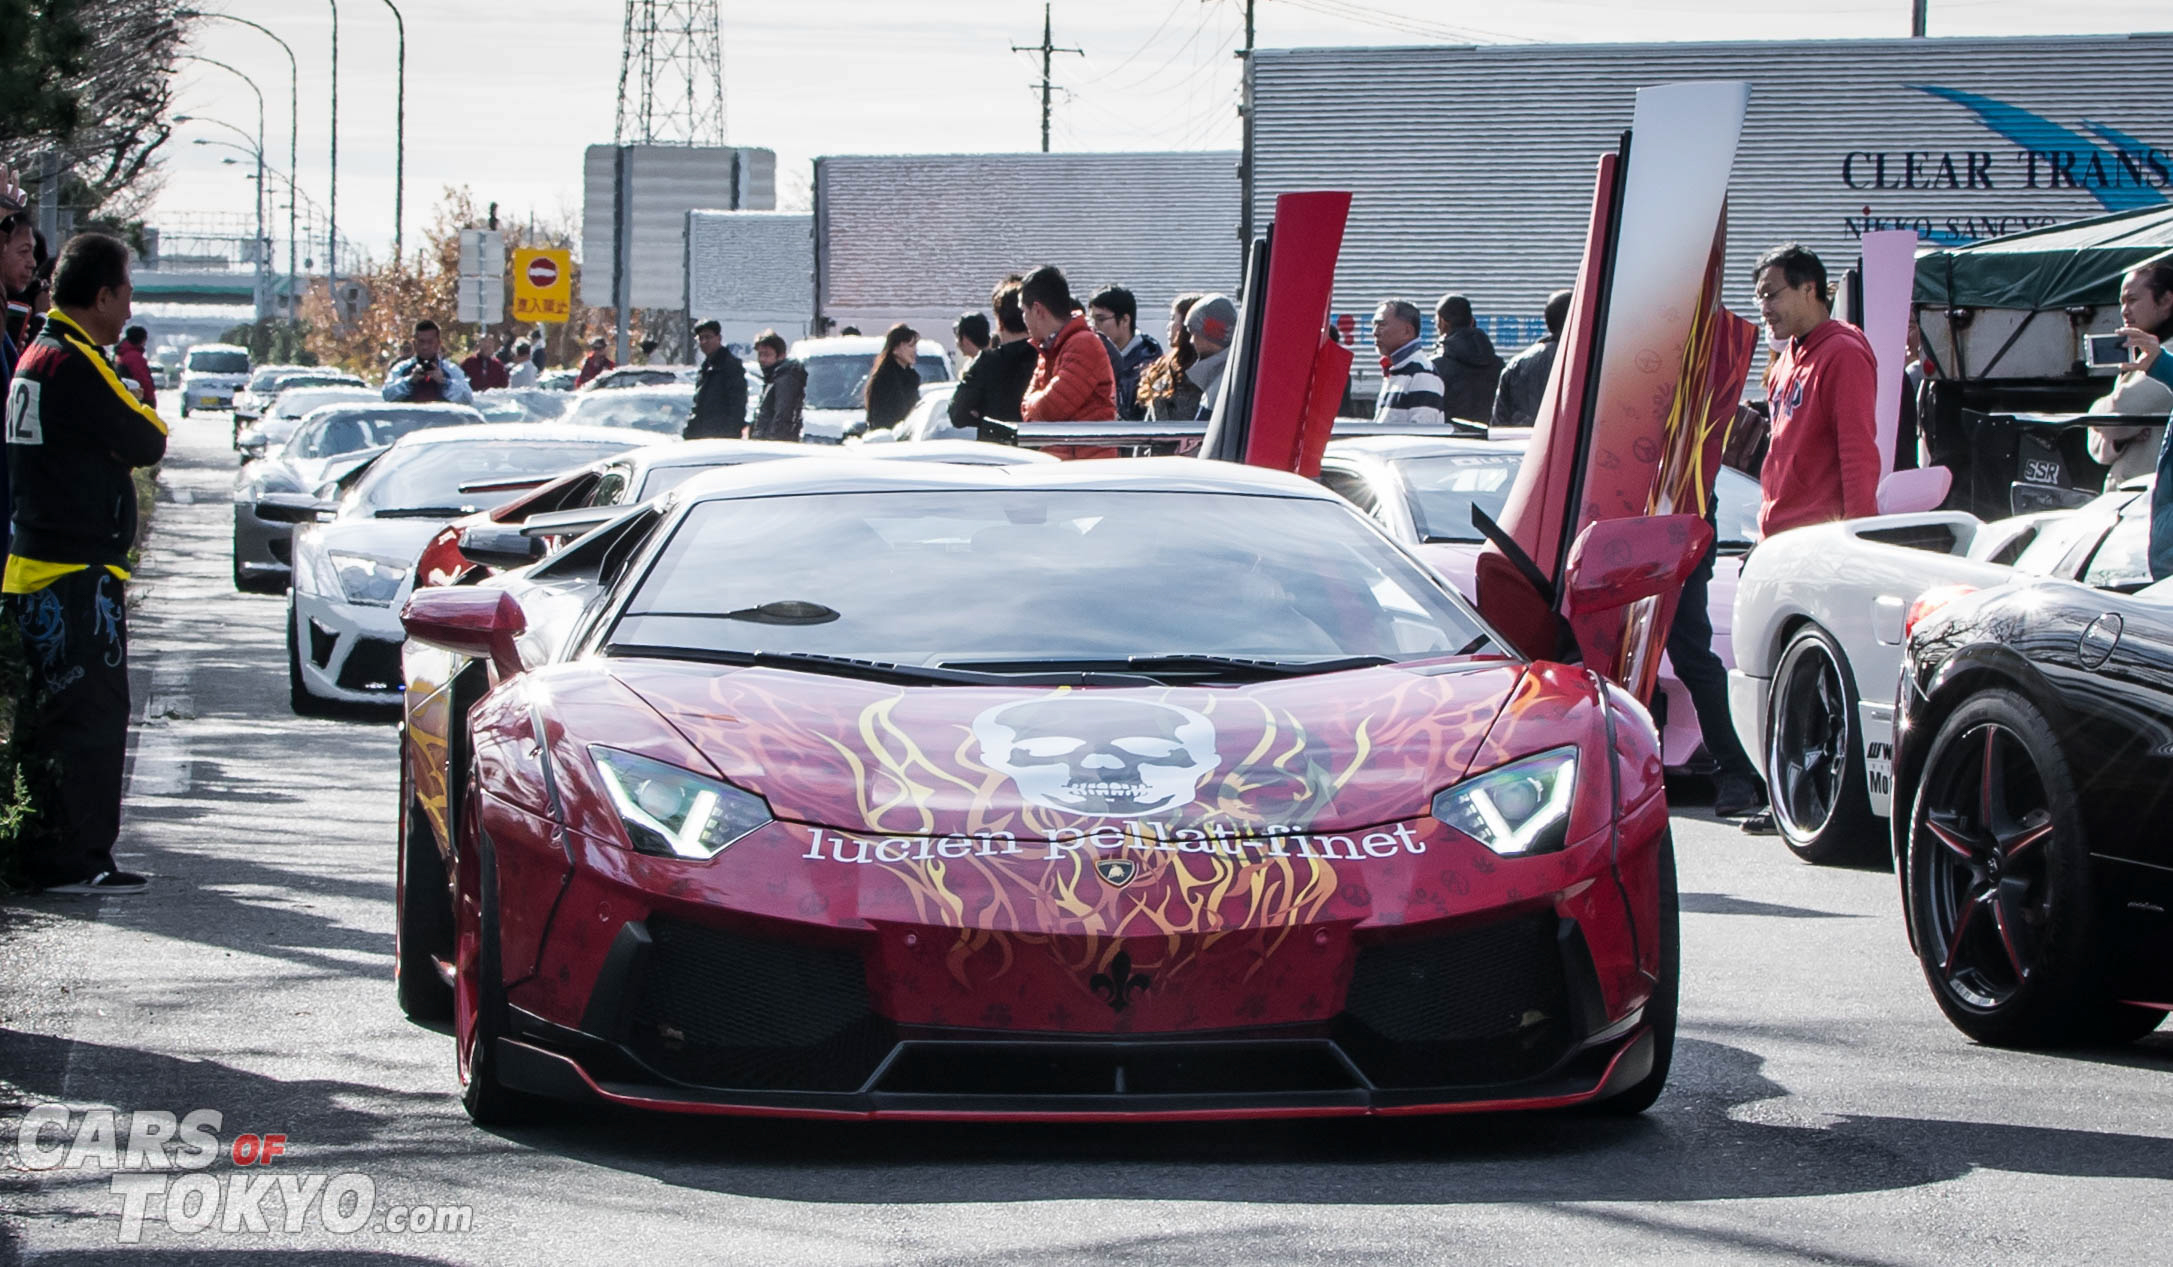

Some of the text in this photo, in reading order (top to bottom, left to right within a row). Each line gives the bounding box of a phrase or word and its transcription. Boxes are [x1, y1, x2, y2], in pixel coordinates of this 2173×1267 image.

[1842, 150, 2170, 189] CLEAR TRANS
[2024, 459, 2059, 484] SSR
[802, 821, 1426, 863] lucien pellat-finet
